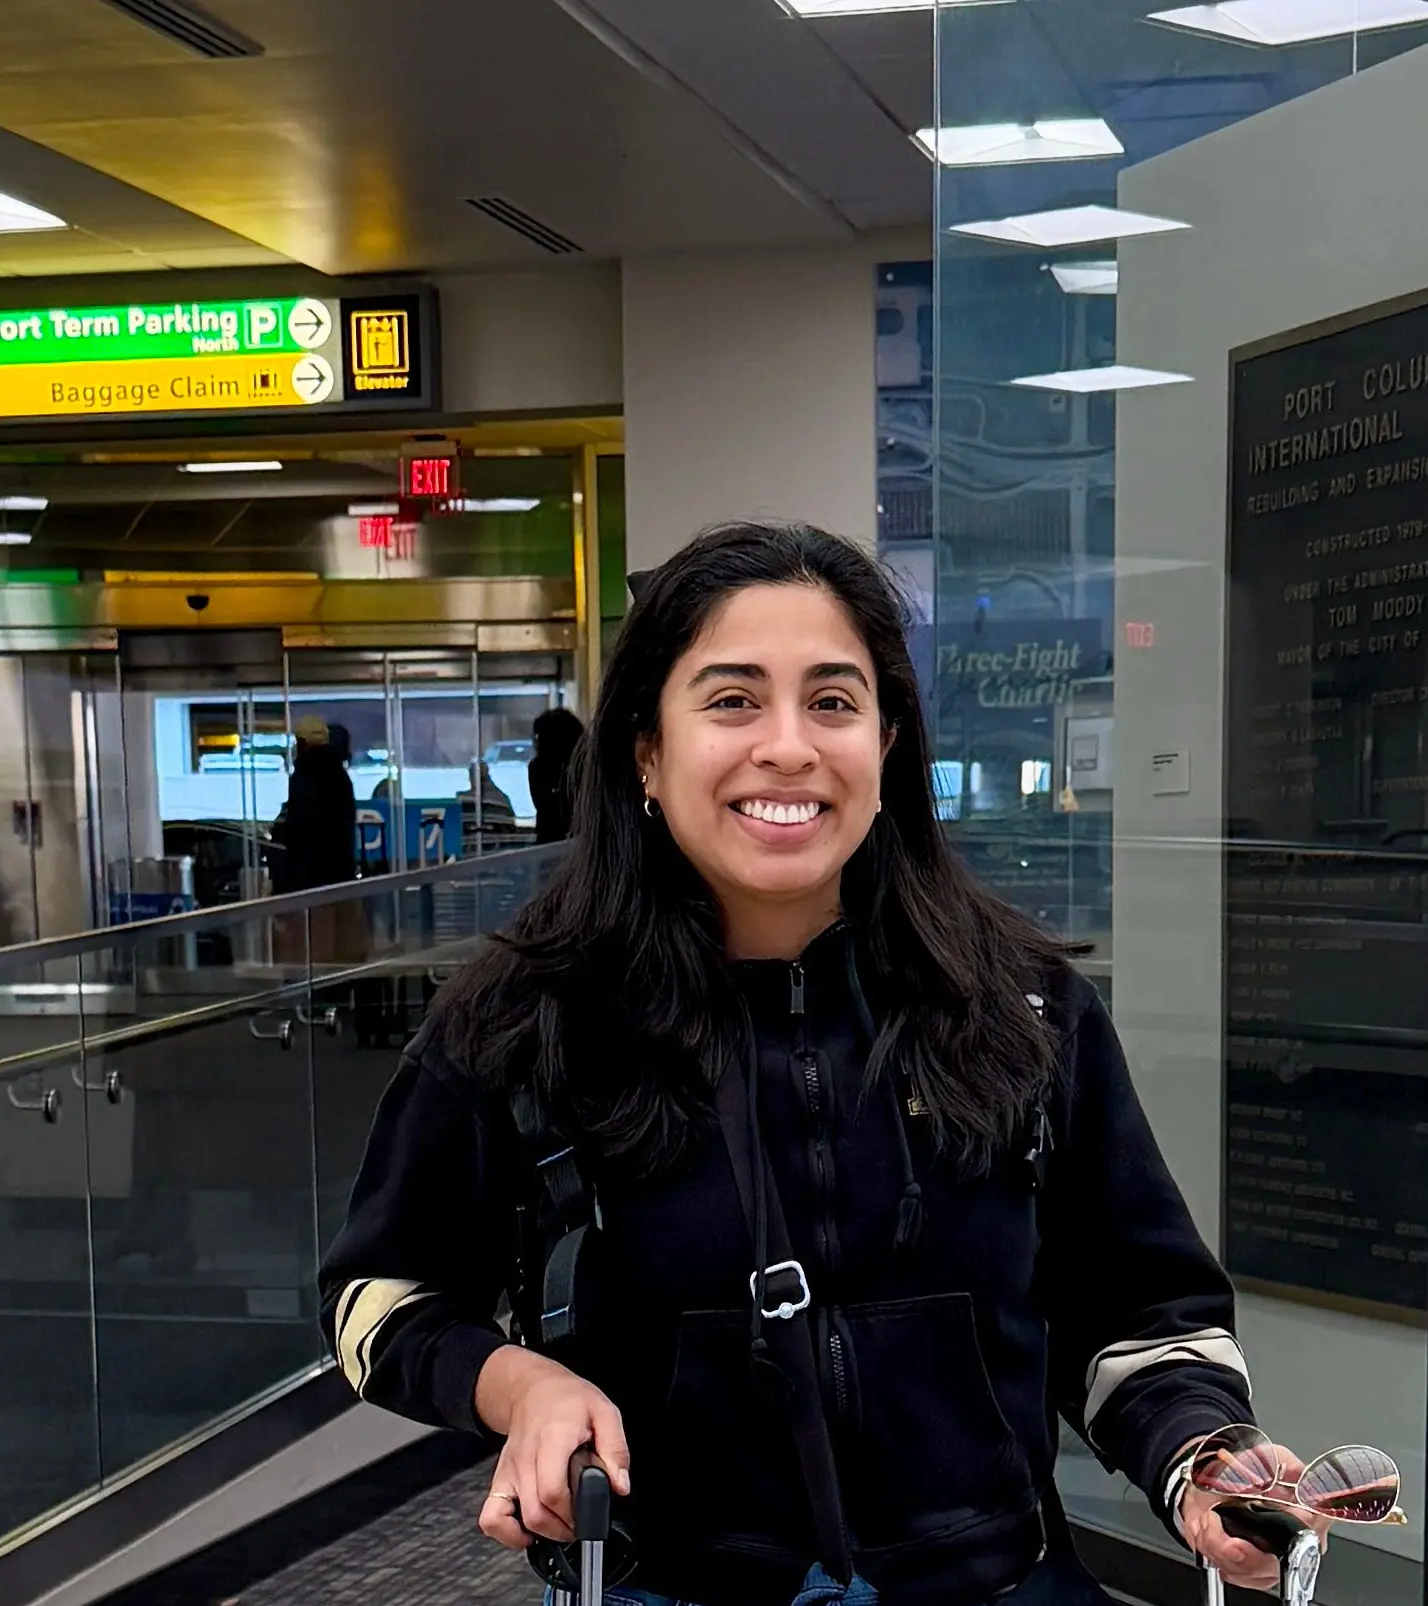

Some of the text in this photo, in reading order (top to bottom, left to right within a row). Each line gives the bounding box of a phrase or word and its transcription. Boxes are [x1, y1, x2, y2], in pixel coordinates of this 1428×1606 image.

[48, 306, 120, 339] Term
[127, 303, 239, 338] Parking
[192, 334, 240, 353] North
[51, 375, 241, 407] Baggage Claim
[1282, 380, 1337, 422] PORT
[1247, 409, 1404, 475] INTERNATIONAL
[411, 458, 452, 494] EXIT
[1246, 479, 1320, 517] REBUILDING
[1328, 472, 1357, 497] AND
[1305, 525, 1392, 558] CONSTRUCTED
[1284, 583, 1322, 603] UNDER
[1327, 576, 1349, 596] THE
[1327, 593, 1426, 628] TOM MOODY
[1317, 643, 1333, 660] OF
[1339, 638, 1360, 658] THE
[1367, 634, 1396, 653] CITY
[1403, 629, 1421, 648] OF
